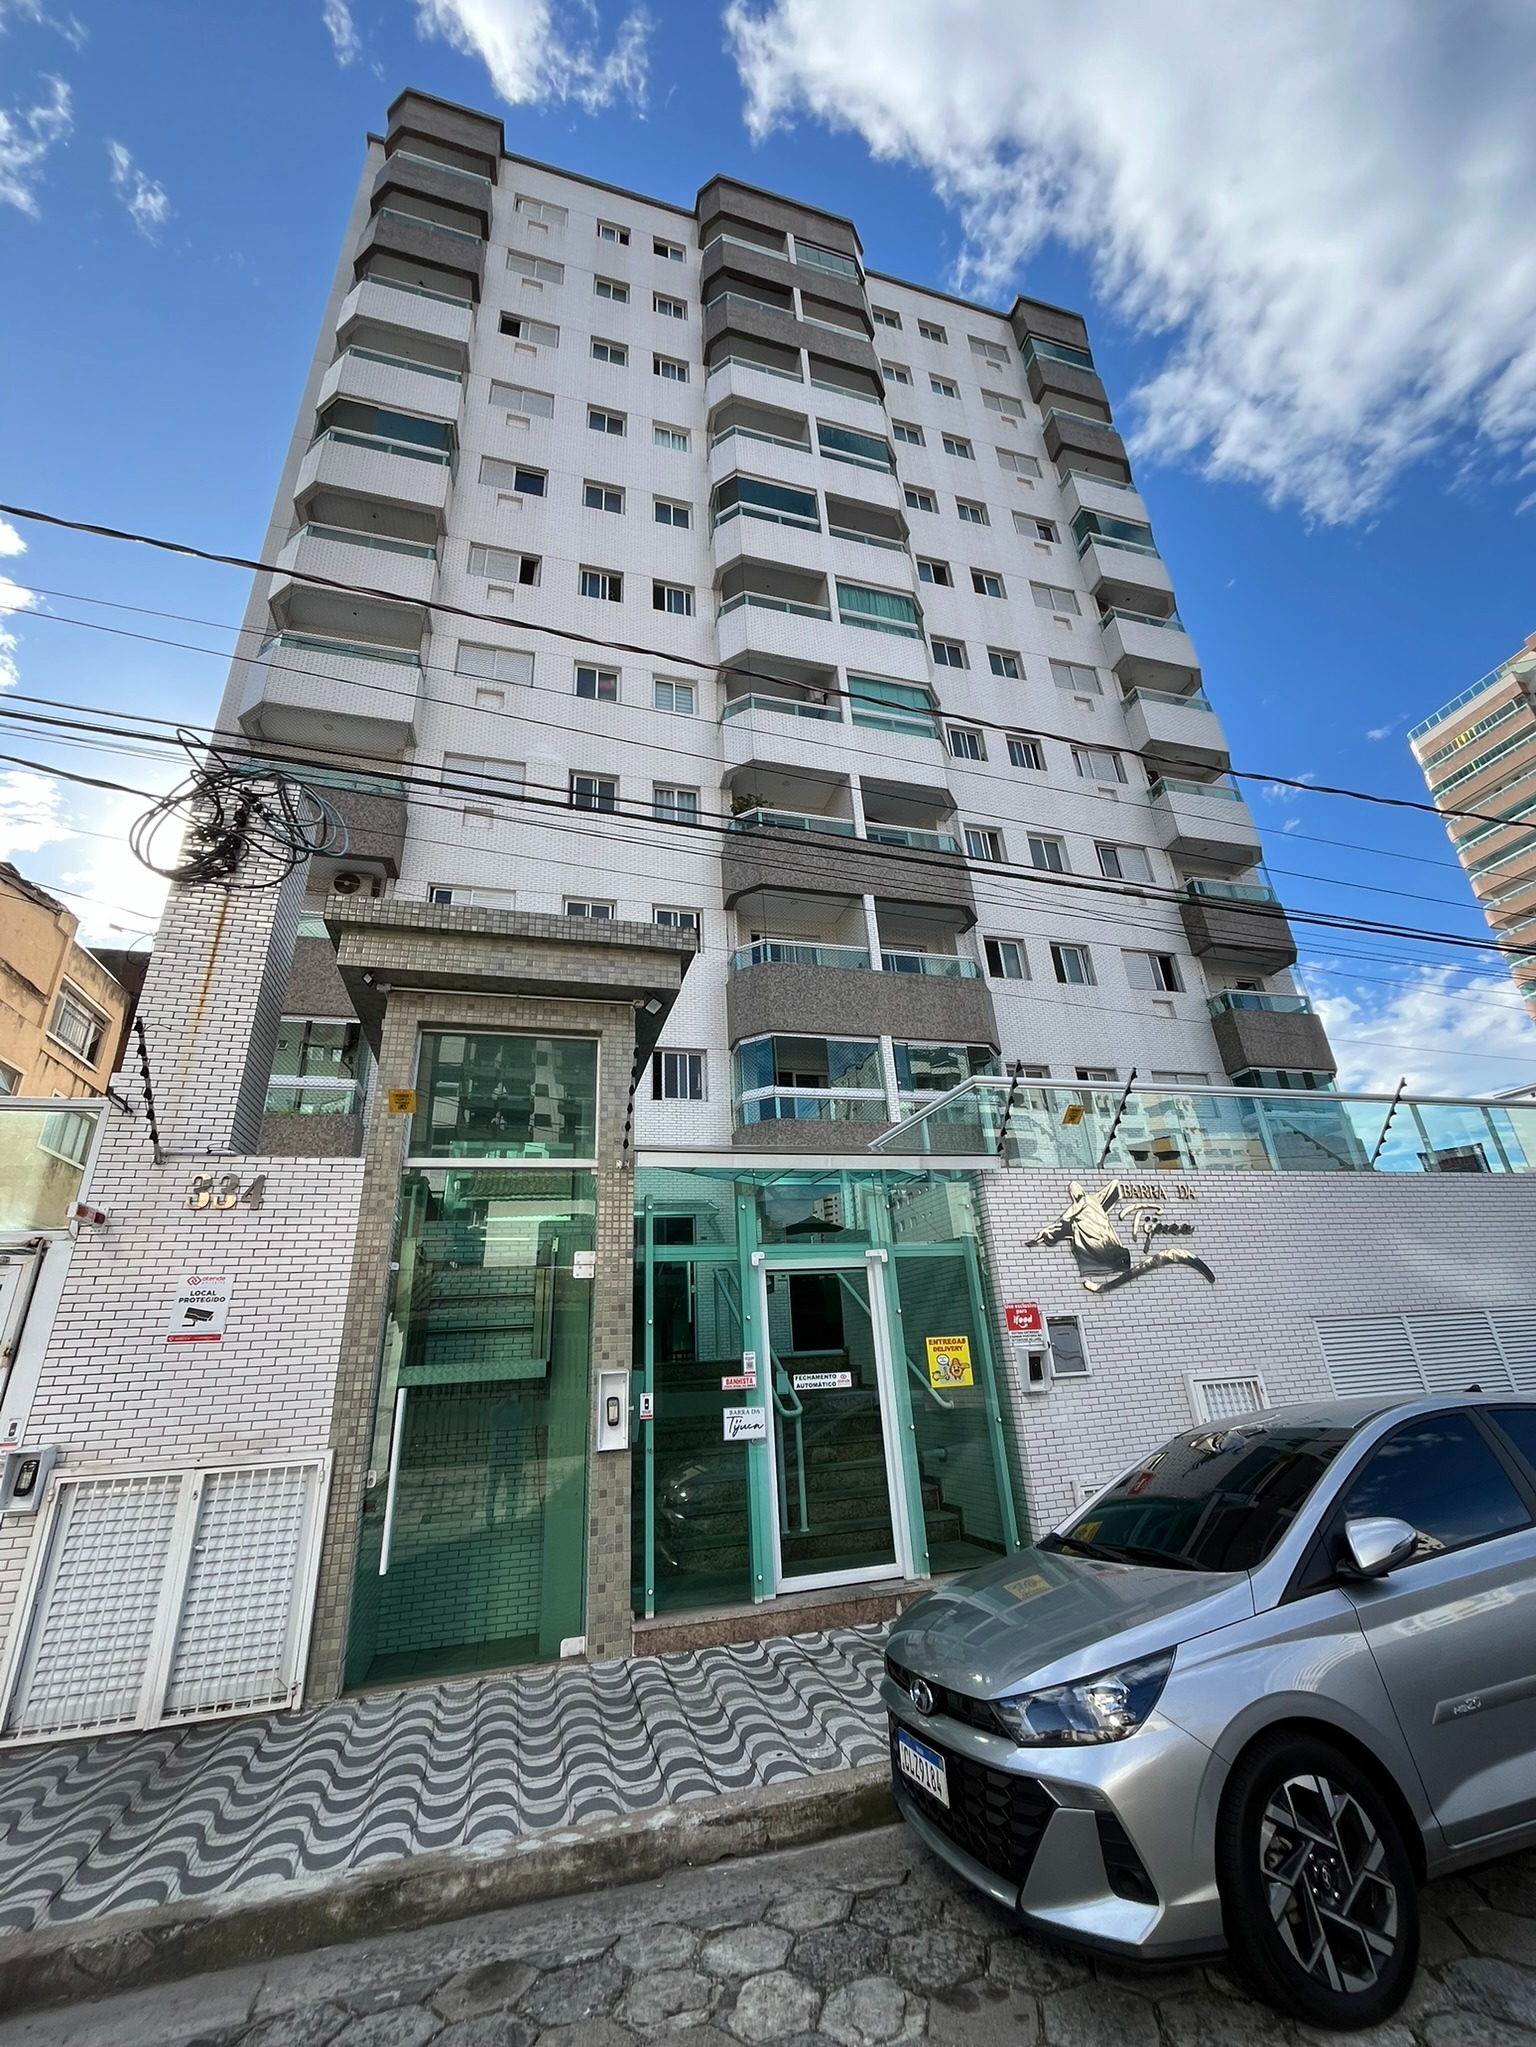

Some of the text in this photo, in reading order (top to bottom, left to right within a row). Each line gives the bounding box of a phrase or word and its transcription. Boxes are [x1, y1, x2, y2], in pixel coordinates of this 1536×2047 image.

[183, 1173, 266, 1210] 334
[1119, 1184, 1196, 1200] BARRA DA
[178, 1296, 226, 1304] PROTEGIDO
[795, 1373, 837, 1381] FECHAMENTO
